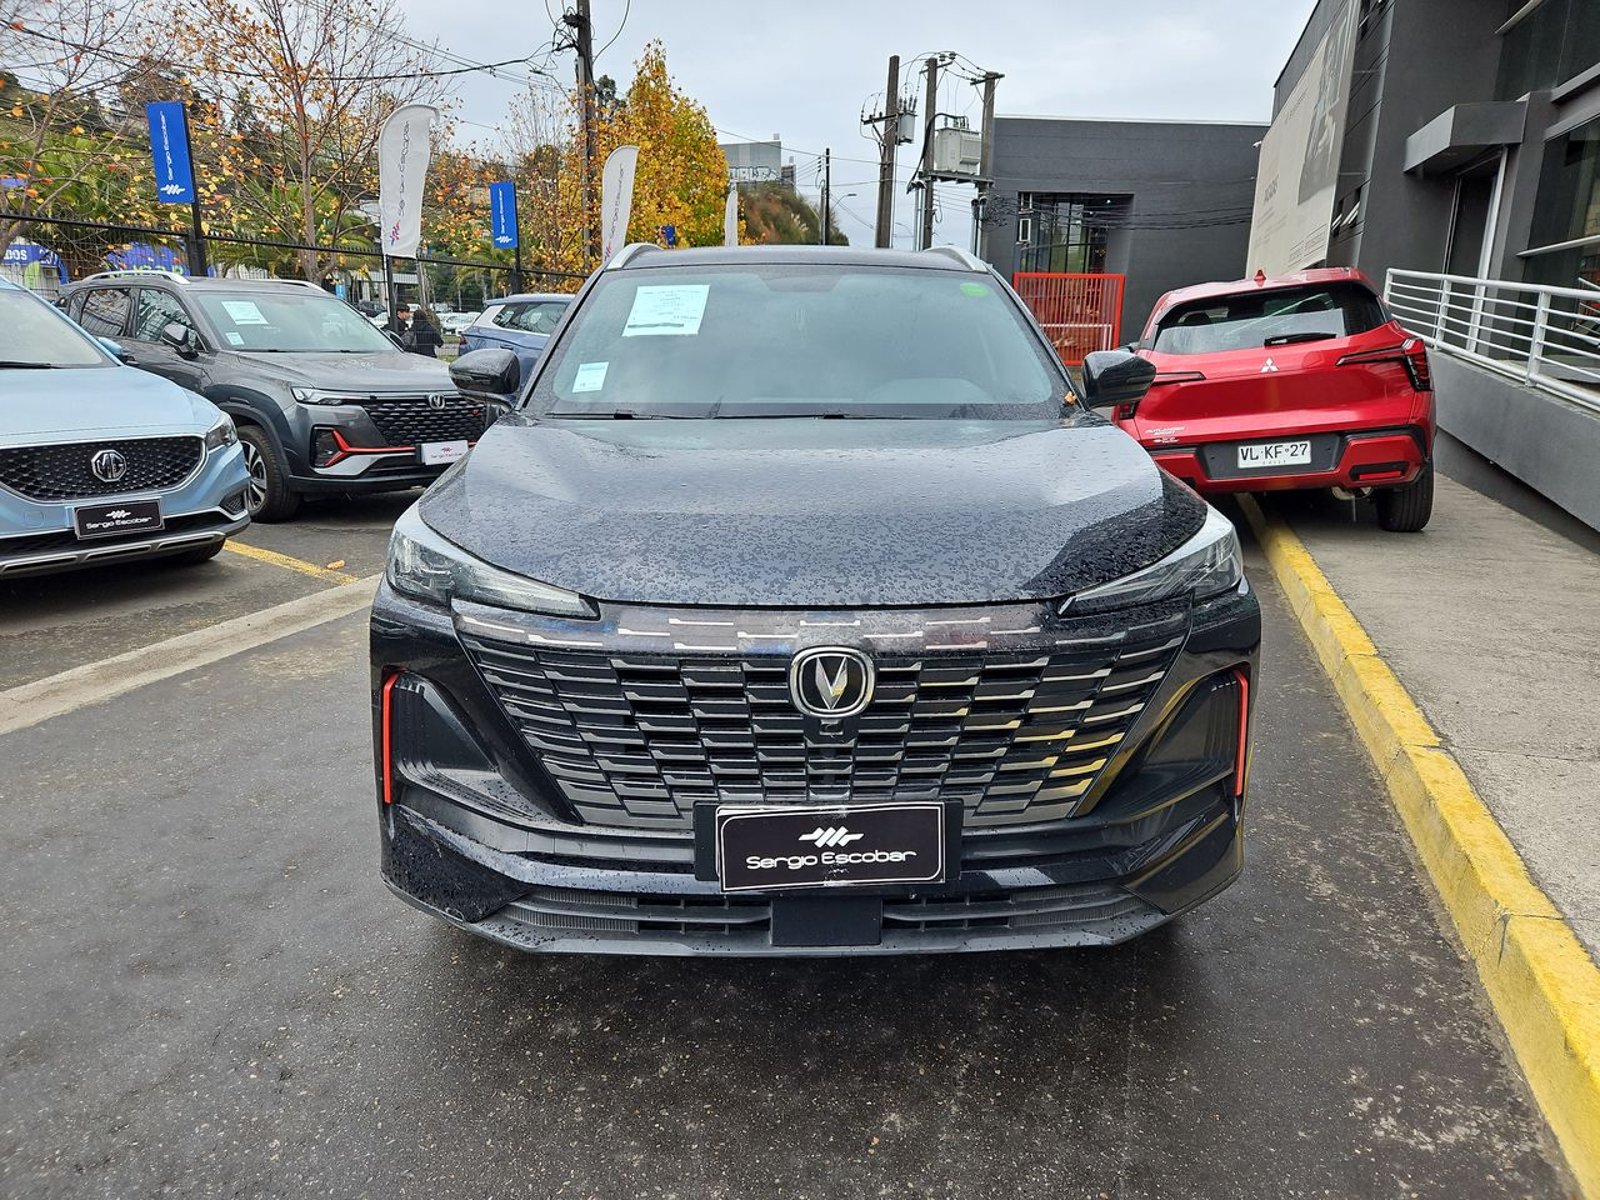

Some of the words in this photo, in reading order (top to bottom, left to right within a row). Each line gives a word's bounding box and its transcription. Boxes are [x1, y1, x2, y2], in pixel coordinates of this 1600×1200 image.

[96, 453, 124, 479] MG
[86, 521, 115, 530] Sergio
[115, 517, 152, 526] Escobar
[746, 854, 818, 870] Sergio
[821, 850, 917, 865] Escobar
